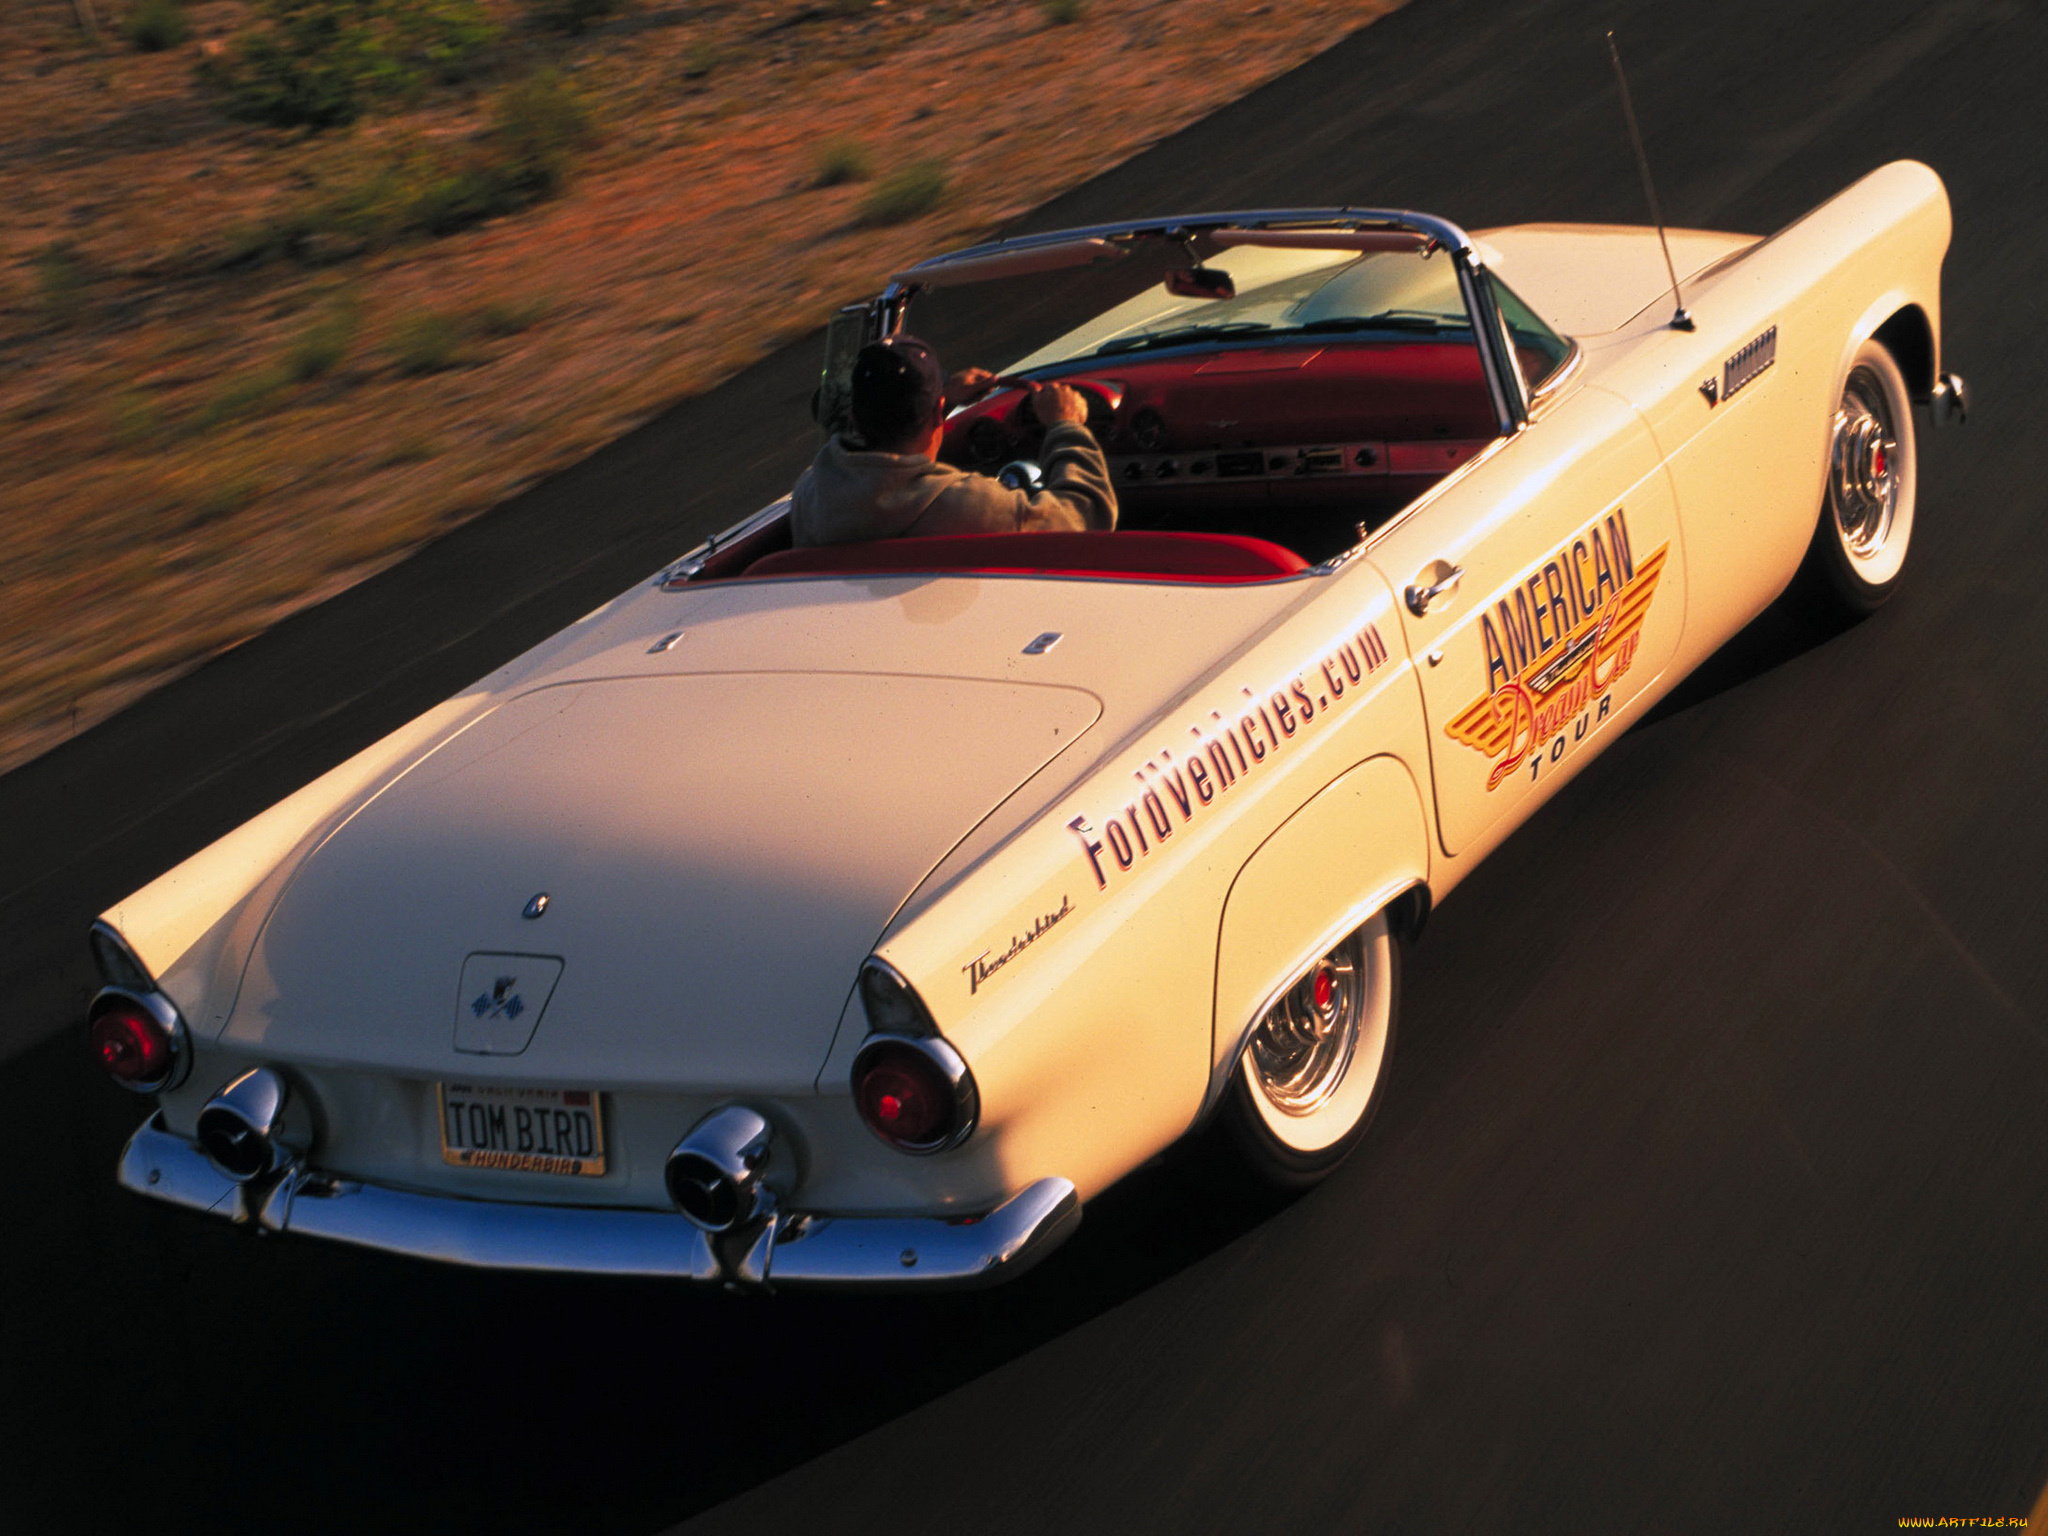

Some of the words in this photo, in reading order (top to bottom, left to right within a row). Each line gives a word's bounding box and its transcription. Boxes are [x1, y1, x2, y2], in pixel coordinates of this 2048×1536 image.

[1480, 507, 1634, 698] AMERICAN
[1487, 675, 1589, 791] Dream
[1592, 588, 1640, 695] Car
[1531, 694, 1611, 782] TOUR
[962, 895, 1075, 995] Thunderbird
[450, 1102, 507, 1150] TOM
[515, 1106, 593, 1156] BIRD
